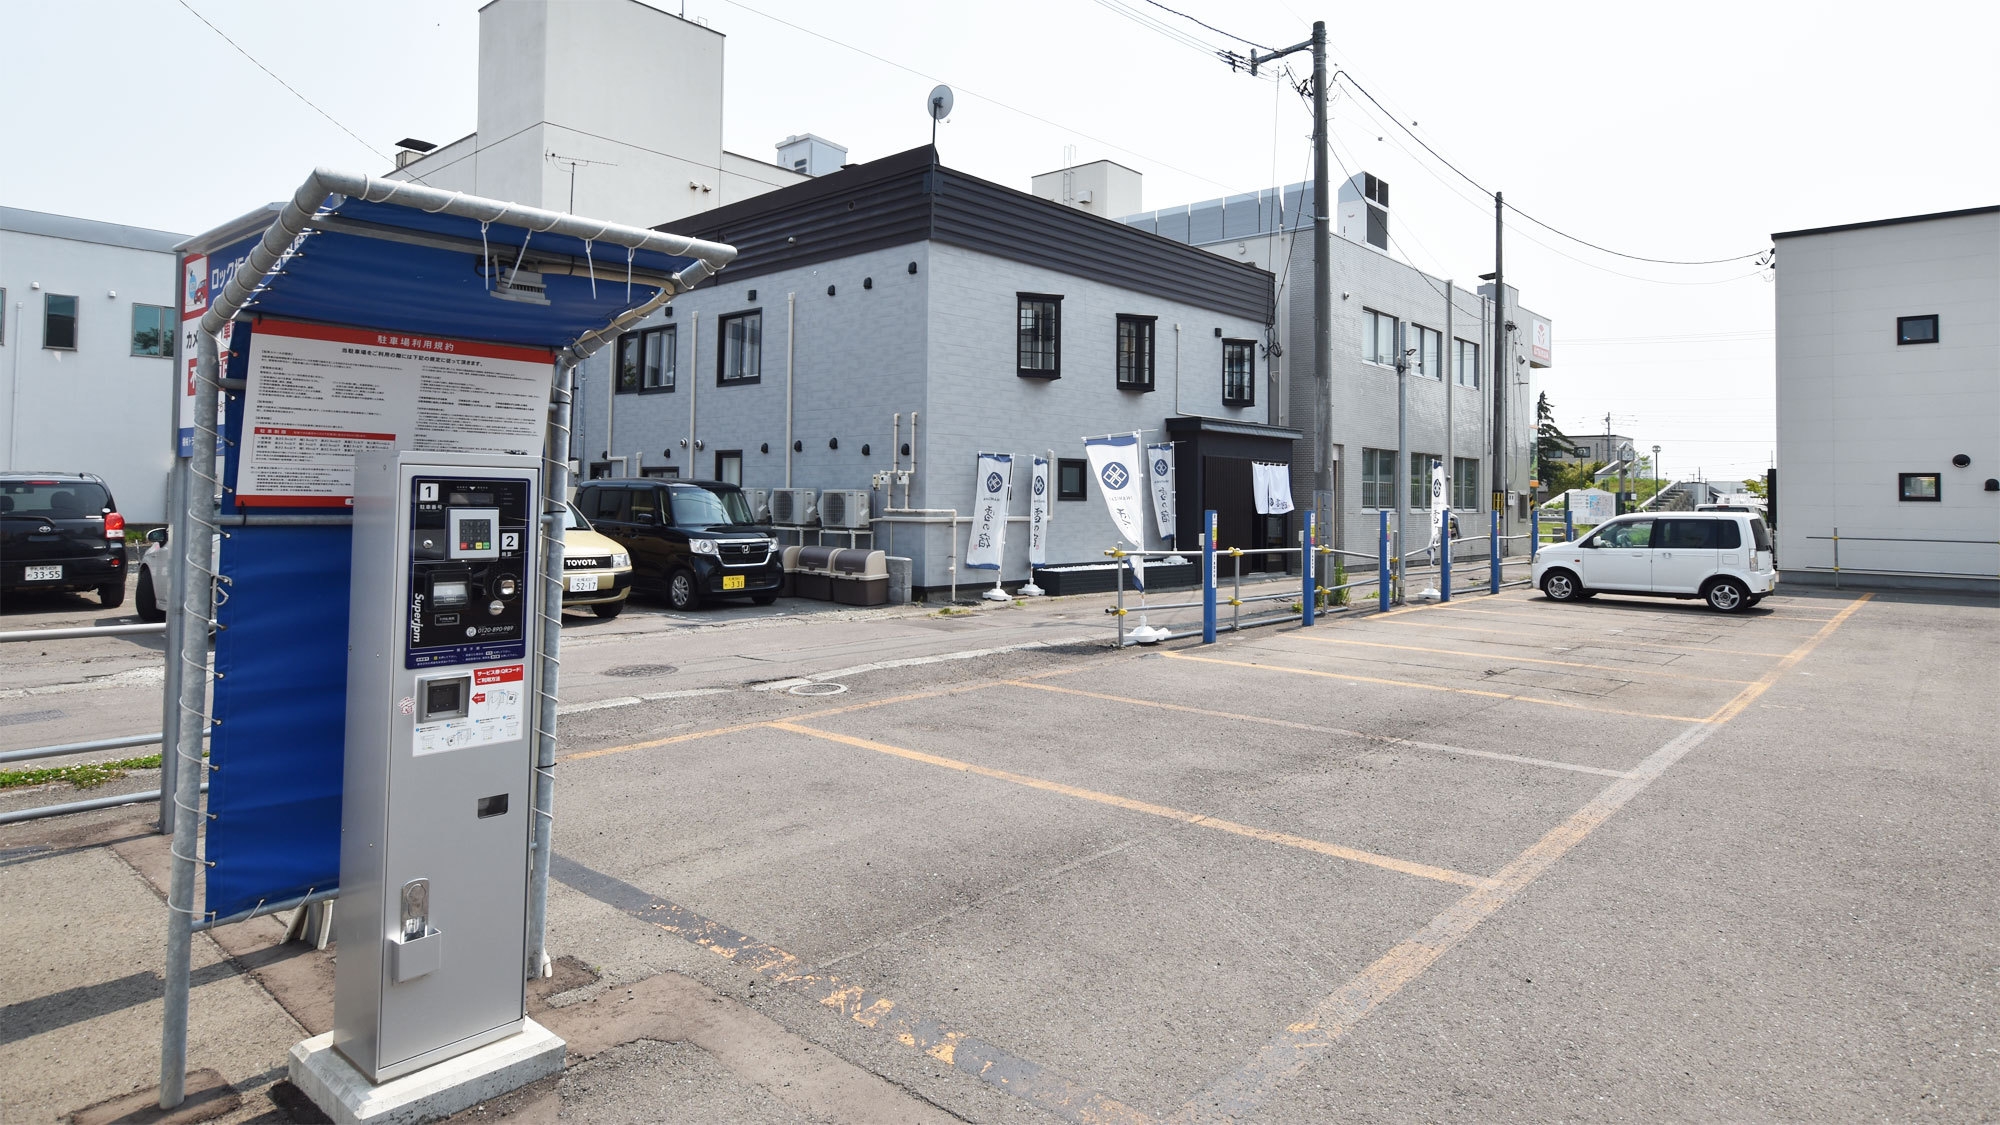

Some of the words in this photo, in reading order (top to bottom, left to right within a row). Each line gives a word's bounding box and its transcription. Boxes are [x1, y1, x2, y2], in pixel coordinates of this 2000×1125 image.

[377, 335, 454, 352] 駐車場利用規約
[425, 485, 432, 498] 1
[505, 535, 514, 547] 2
[566, 559, 597, 567] TOYOTA
[34, 570, 60, 579] 33-55
[576, 582, 596, 590] 52-17
[411, 592, 424, 643] Superjpm
